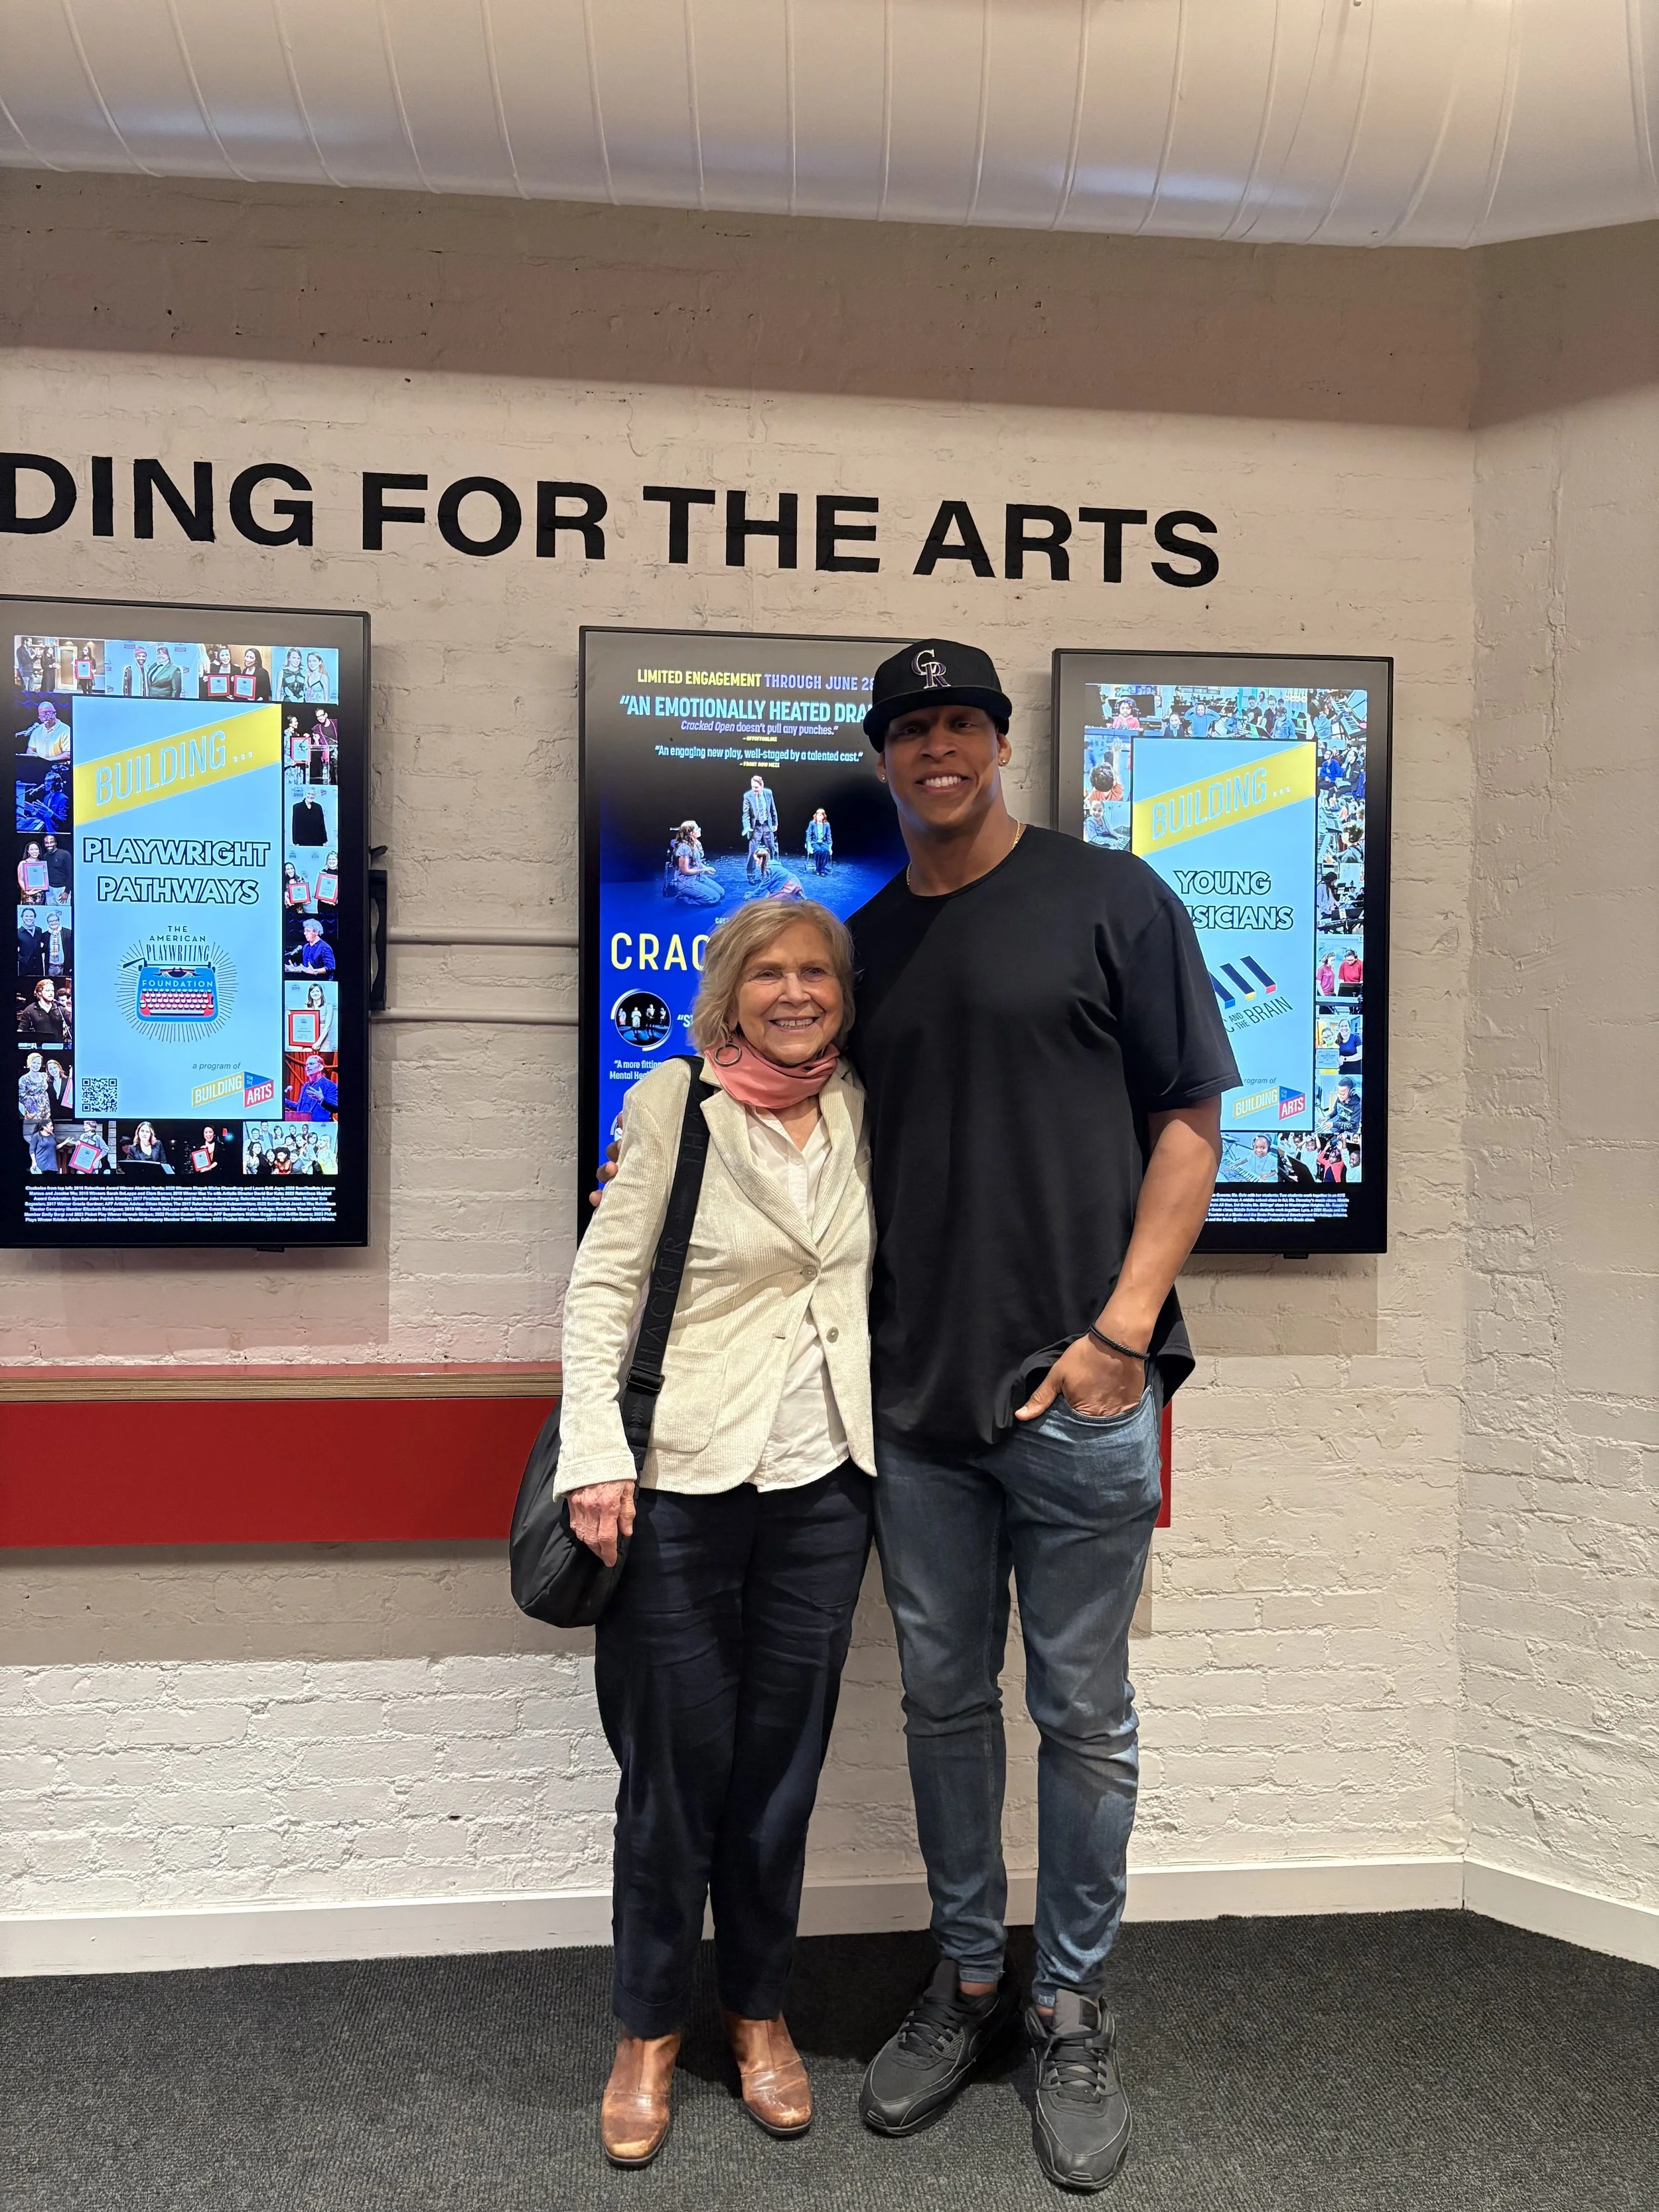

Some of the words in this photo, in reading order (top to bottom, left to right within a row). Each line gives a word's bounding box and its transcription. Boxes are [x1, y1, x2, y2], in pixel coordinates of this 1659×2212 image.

[0, 452, 313, 548] DING
[362, 471, 607, 560] FOR
[643, 486, 880, 573] THE
[912, 500, 1220, 588] ARTS
[637, 669, 682, 684] LIMITED
[685, 671, 762, 688] ENGAGEMENT
[764, 674, 822, 690] THROUGH
[826, 676, 857, 690] JUNE
[620, 696, 650, 715] “AN
[656, 697, 766, 719] EMOTIONALLY
[770, 701, 830, 722] HEATED
[835, 703, 873, 723] DRA
[682, 721, 713, 731] Cracked
[715, 722, 735, 733] Open
[767, 724, 782, 735] pull
[783, 726, 797, 737] any
[670, 747, 705, 759] engaging
[725, 747, 743, 760] play,
[745, 748, 789, 761] well-staged
[790, 749, 800, 761] by
[807, 751, 839, 761] talented
[96, 731, 226, 806] BUILDING
[1152, 768, 1267, 840] BUILDING
[83, 838, 271, 867] PLAYWRIGHT
[98, 876, 259, 905] PATHWAYS
[1173, 870, 1271, 895] YOUNG
[146, 944, 209, 962] PLAYWRITING
[1228, 1012, 1244, 1022] AND
[1243, 997, 1293, 1023] BRAIN
[1234, 1019, 1250, 1029] THE
[195, 1075, 242, 1104] BUILDING
[247, 1083, 272, 1104] ARTS
[1235, 1089, 1277, 1116] BUILDING
[1281, 1097, 1304, 1118] ARTS
